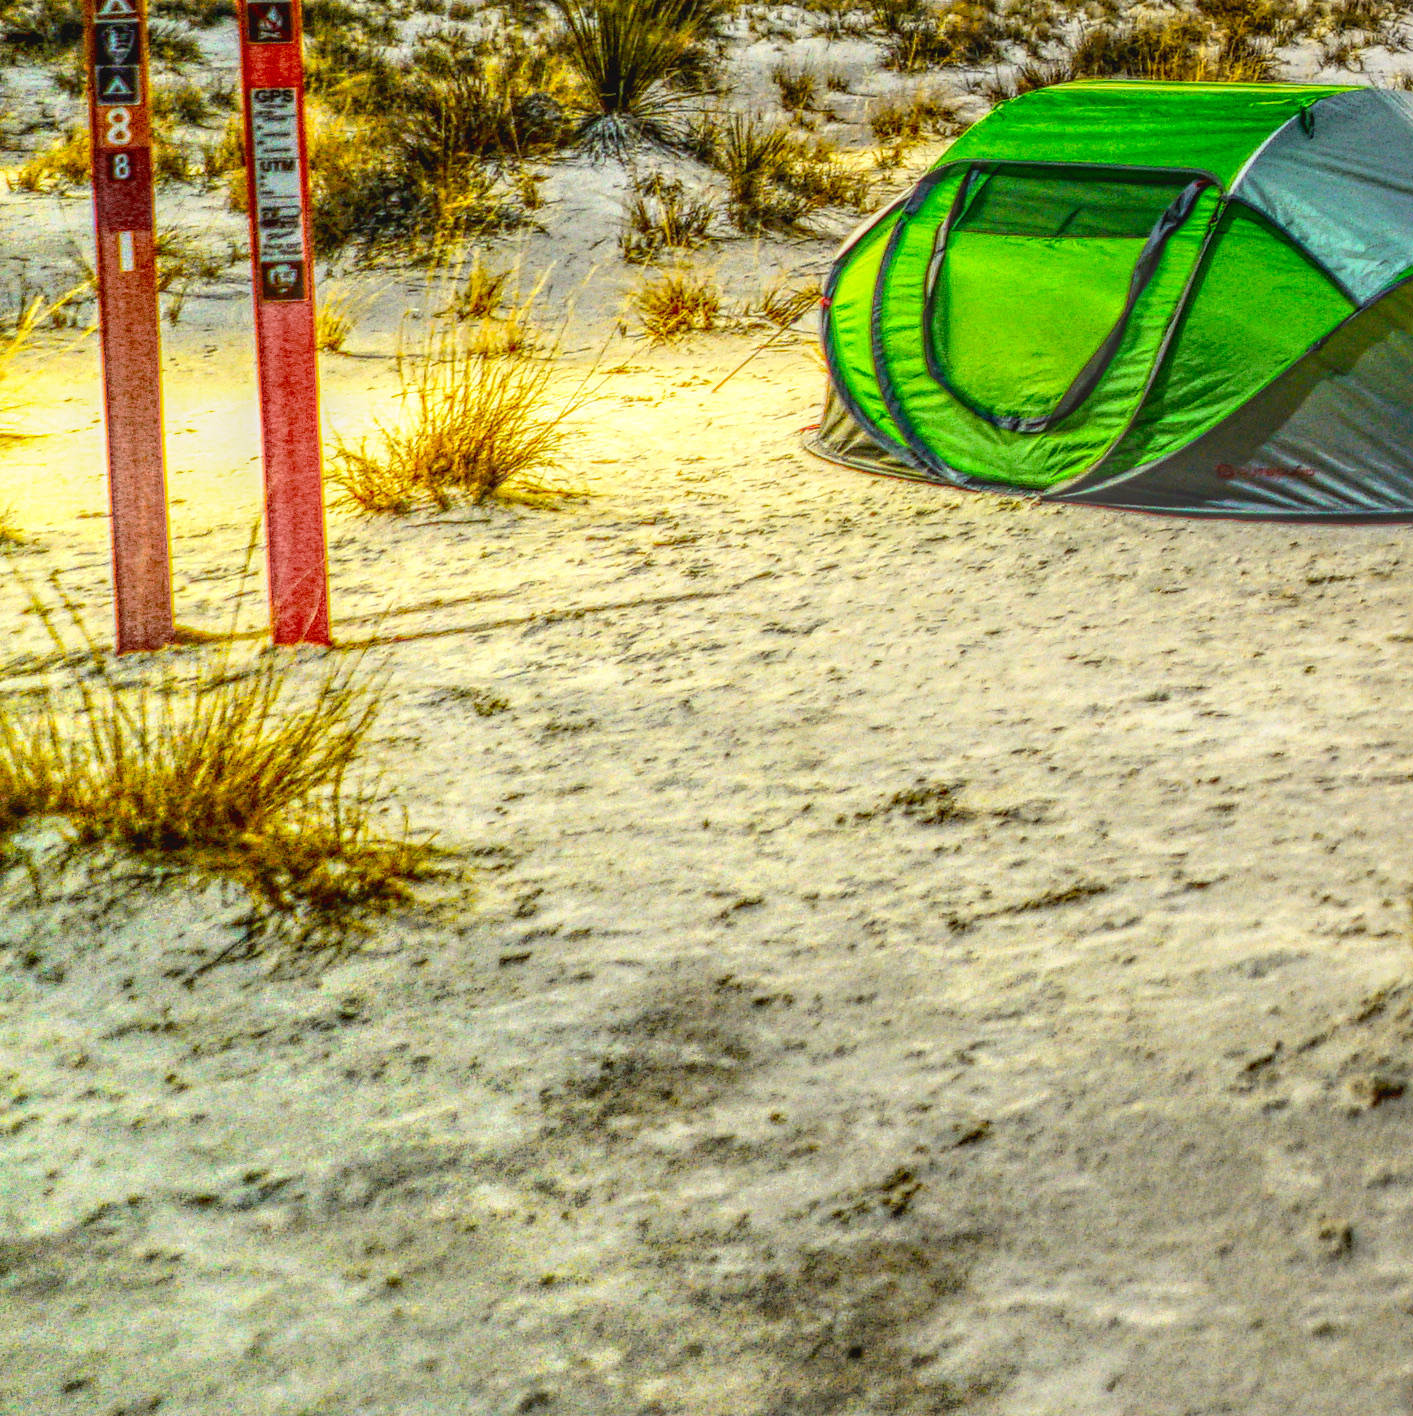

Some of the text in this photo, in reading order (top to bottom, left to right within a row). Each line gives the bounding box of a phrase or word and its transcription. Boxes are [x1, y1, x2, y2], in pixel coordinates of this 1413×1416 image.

[254, 89, 295, 103] GPS
[107, 107, 131, 145] 8
[114, 154, 130, 179] 8
